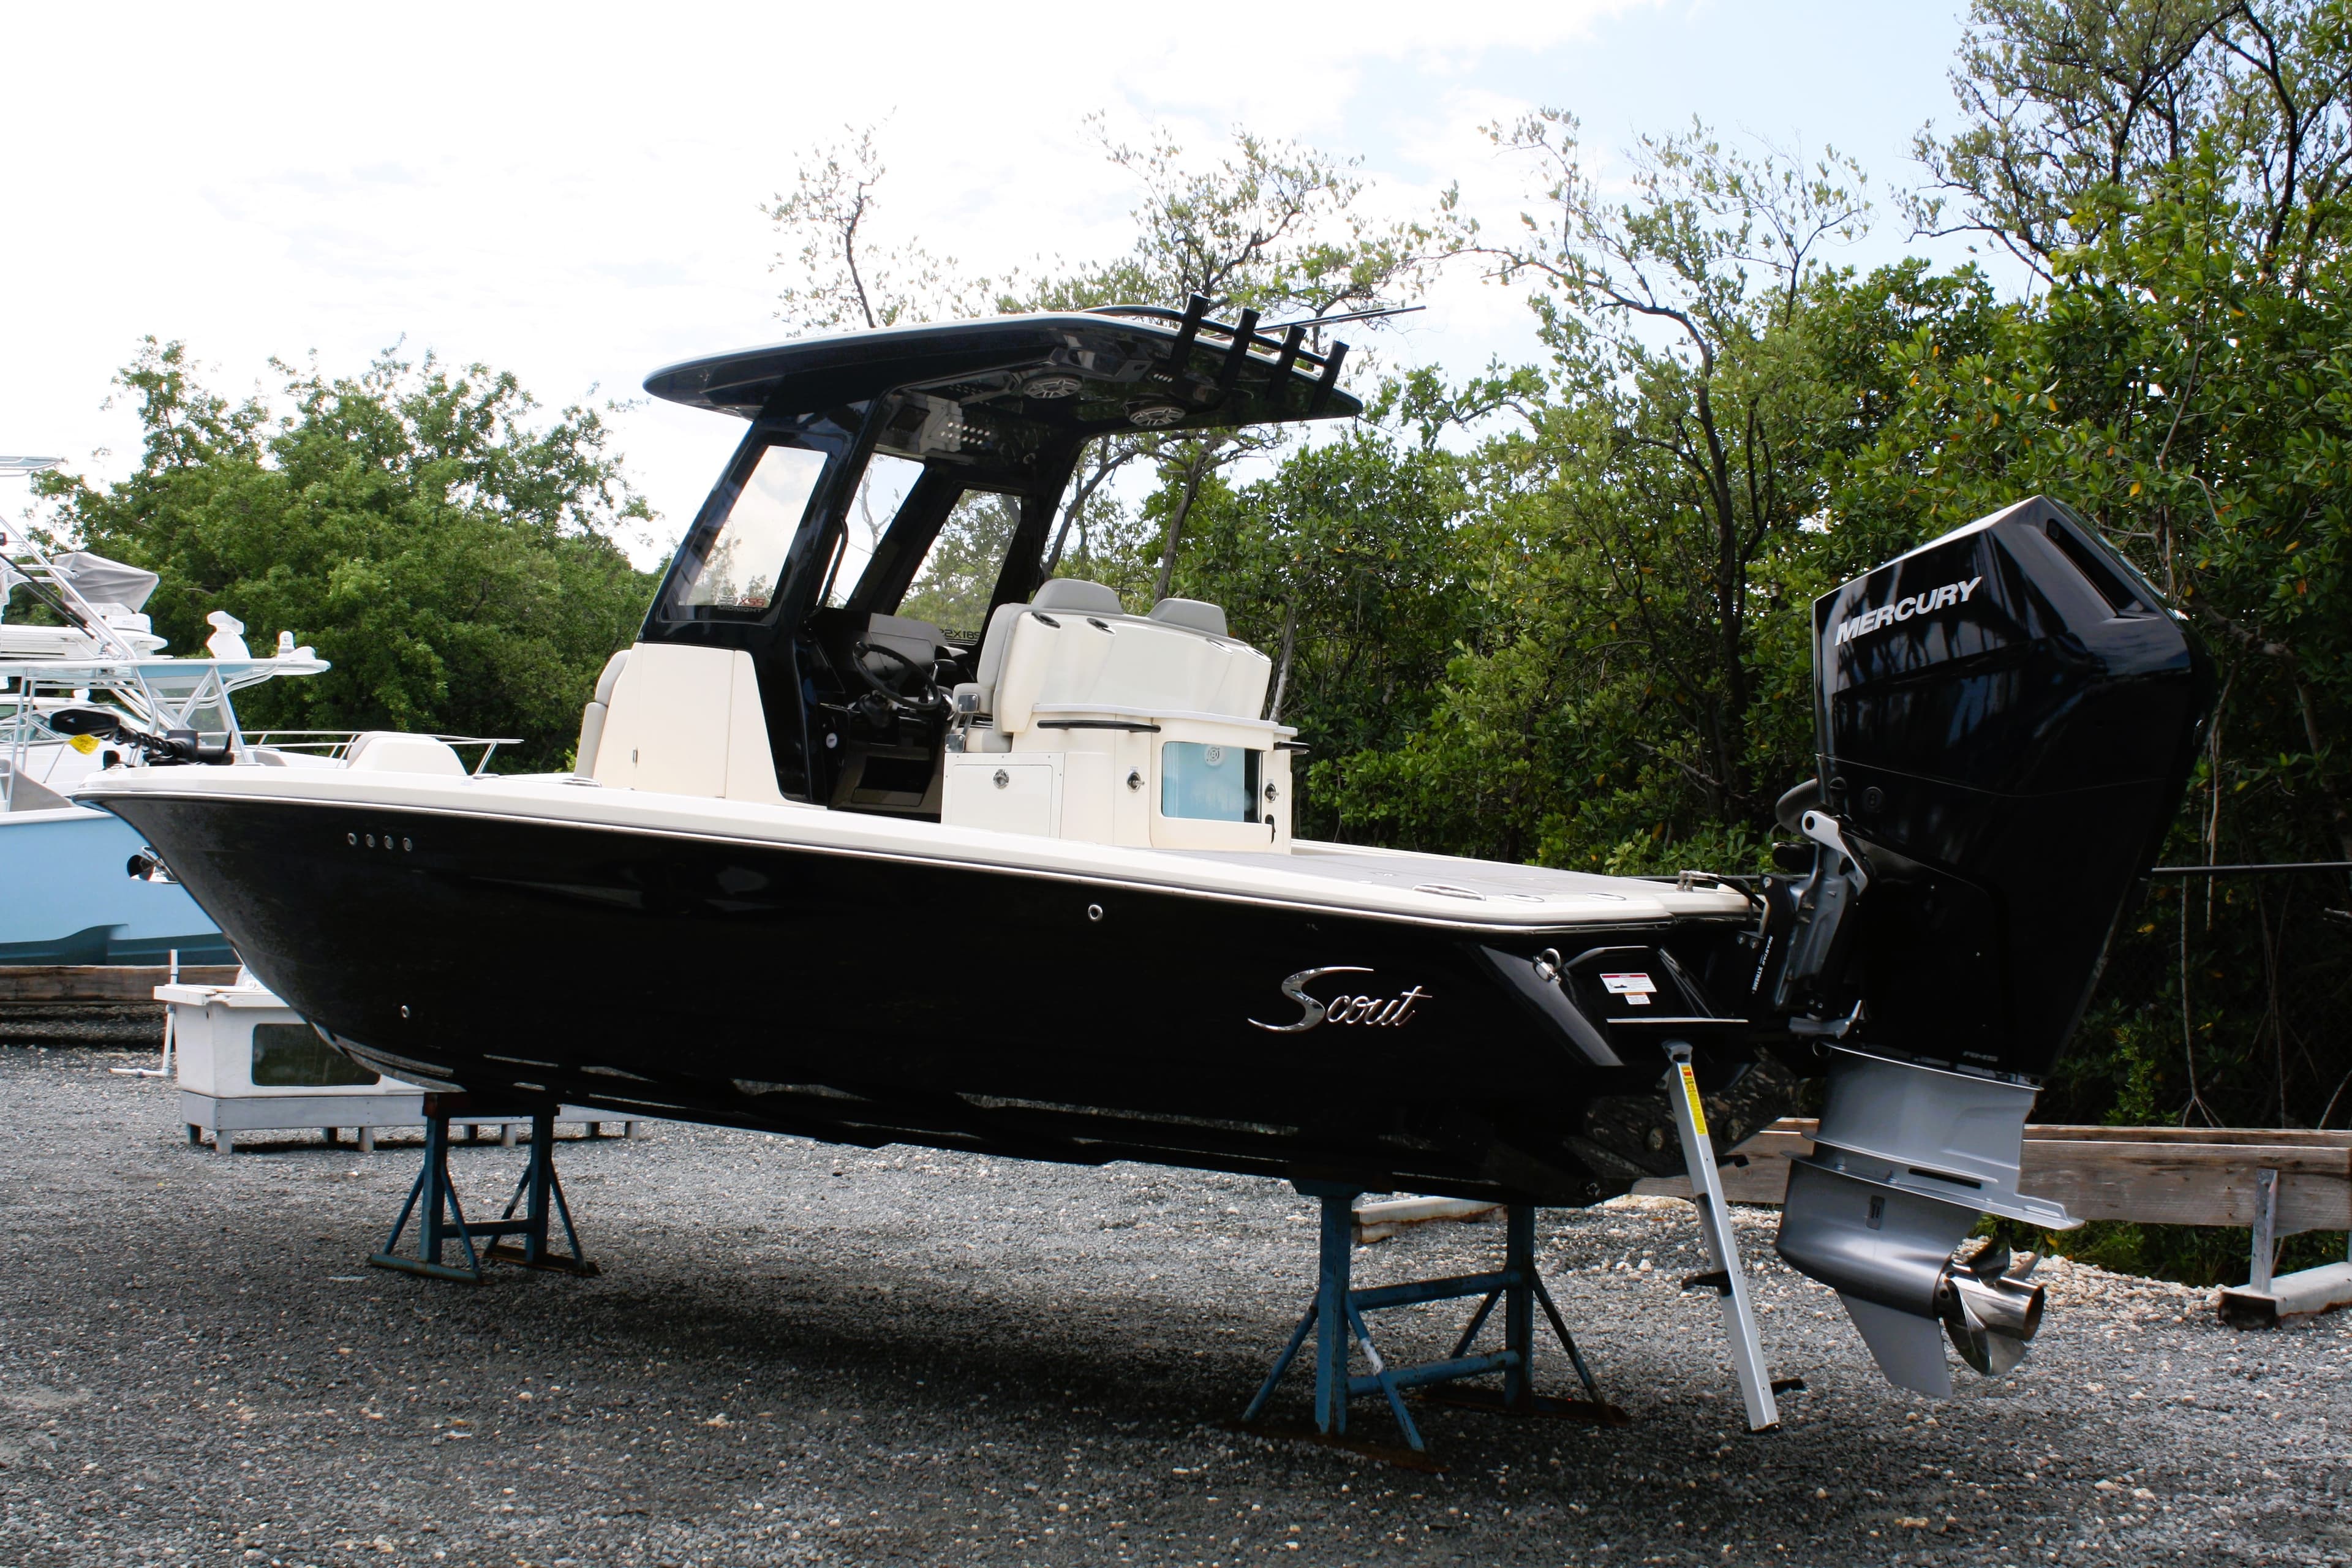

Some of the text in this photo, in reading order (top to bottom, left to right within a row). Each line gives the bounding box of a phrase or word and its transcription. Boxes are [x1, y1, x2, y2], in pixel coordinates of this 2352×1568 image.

[1834, 576, 1982, 646] MERCURY
[1762, 935, 1774, 966] SEASTAR
[1247, 965, 1433, 1033] Scout
[1752, 965, 1763, 991] XTREME
